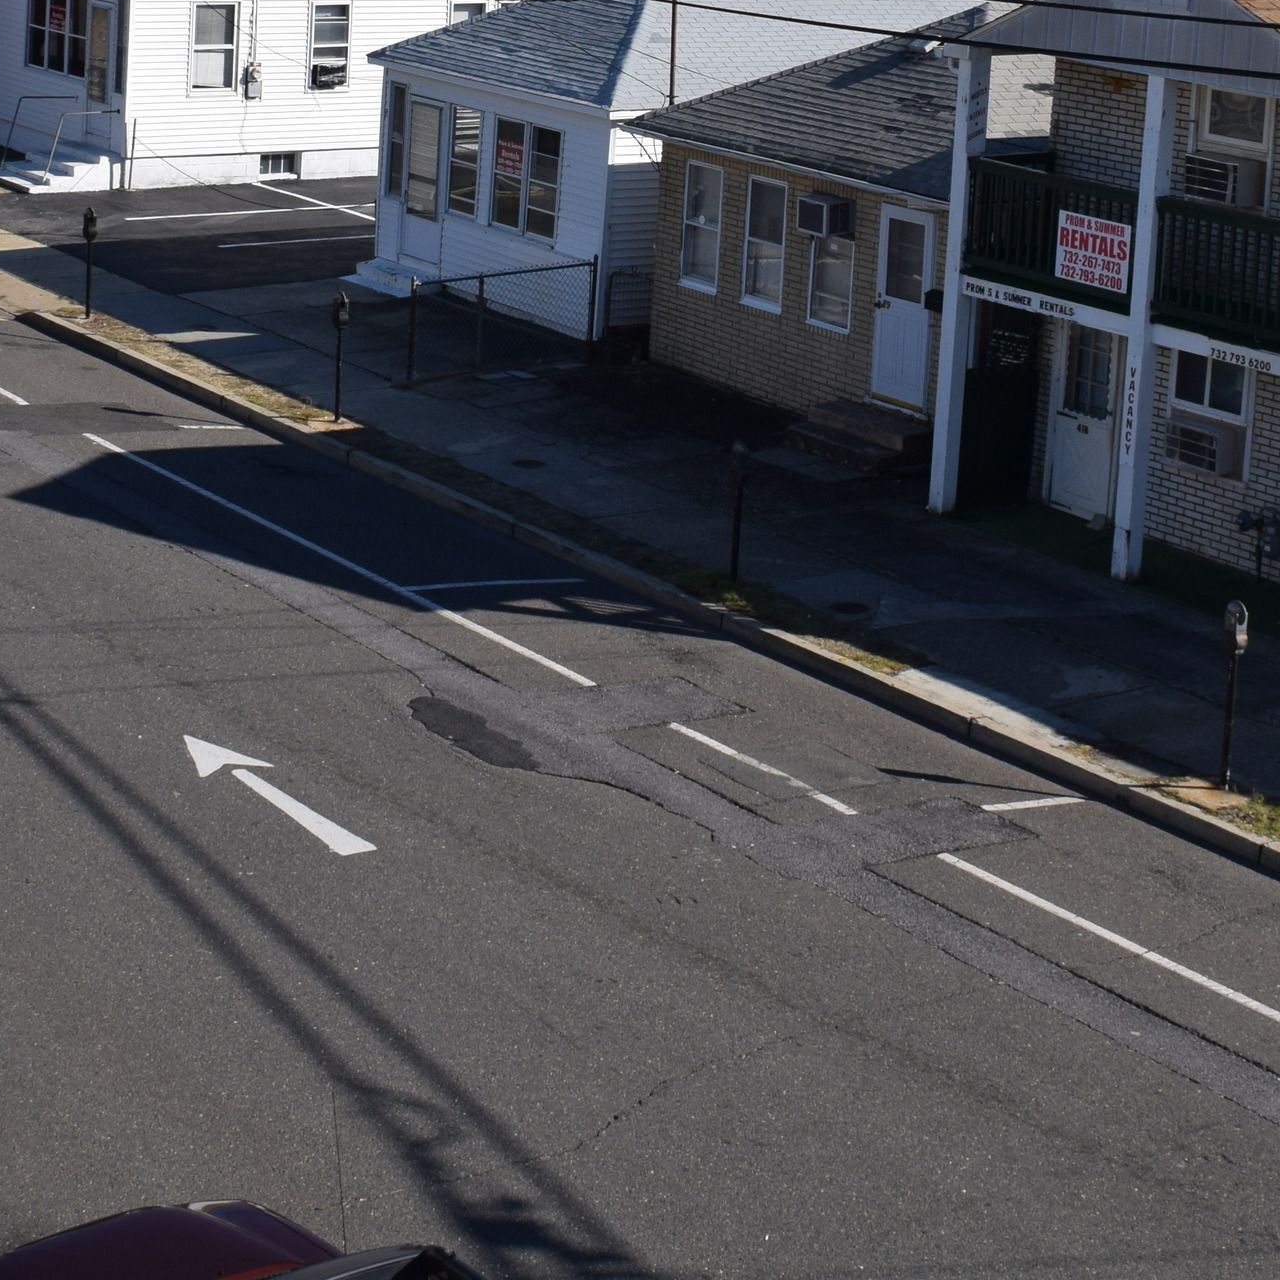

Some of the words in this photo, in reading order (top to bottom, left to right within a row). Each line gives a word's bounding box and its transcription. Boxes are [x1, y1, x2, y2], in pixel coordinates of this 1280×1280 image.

[1064, 213, 1086, 229] PROM
[1094, 220, 1125, 238] SUMMER
[1059, 226, 1128, 261] RENTALS
[1063, 250, 1121, 275] 732-267-7473
[1060, 263, 1123, 290] 732-793-6200
[1003, 292, 1032, 307] SUMMER
[1039, 300, 1075, 317] RENTALS
[1210, 347, 1228, 362] 732
[1229, 352, 1246, 366] 793
[1248, 357, 1272, 372] 6200
[1124, 367, 1137, 455] VACANCY
